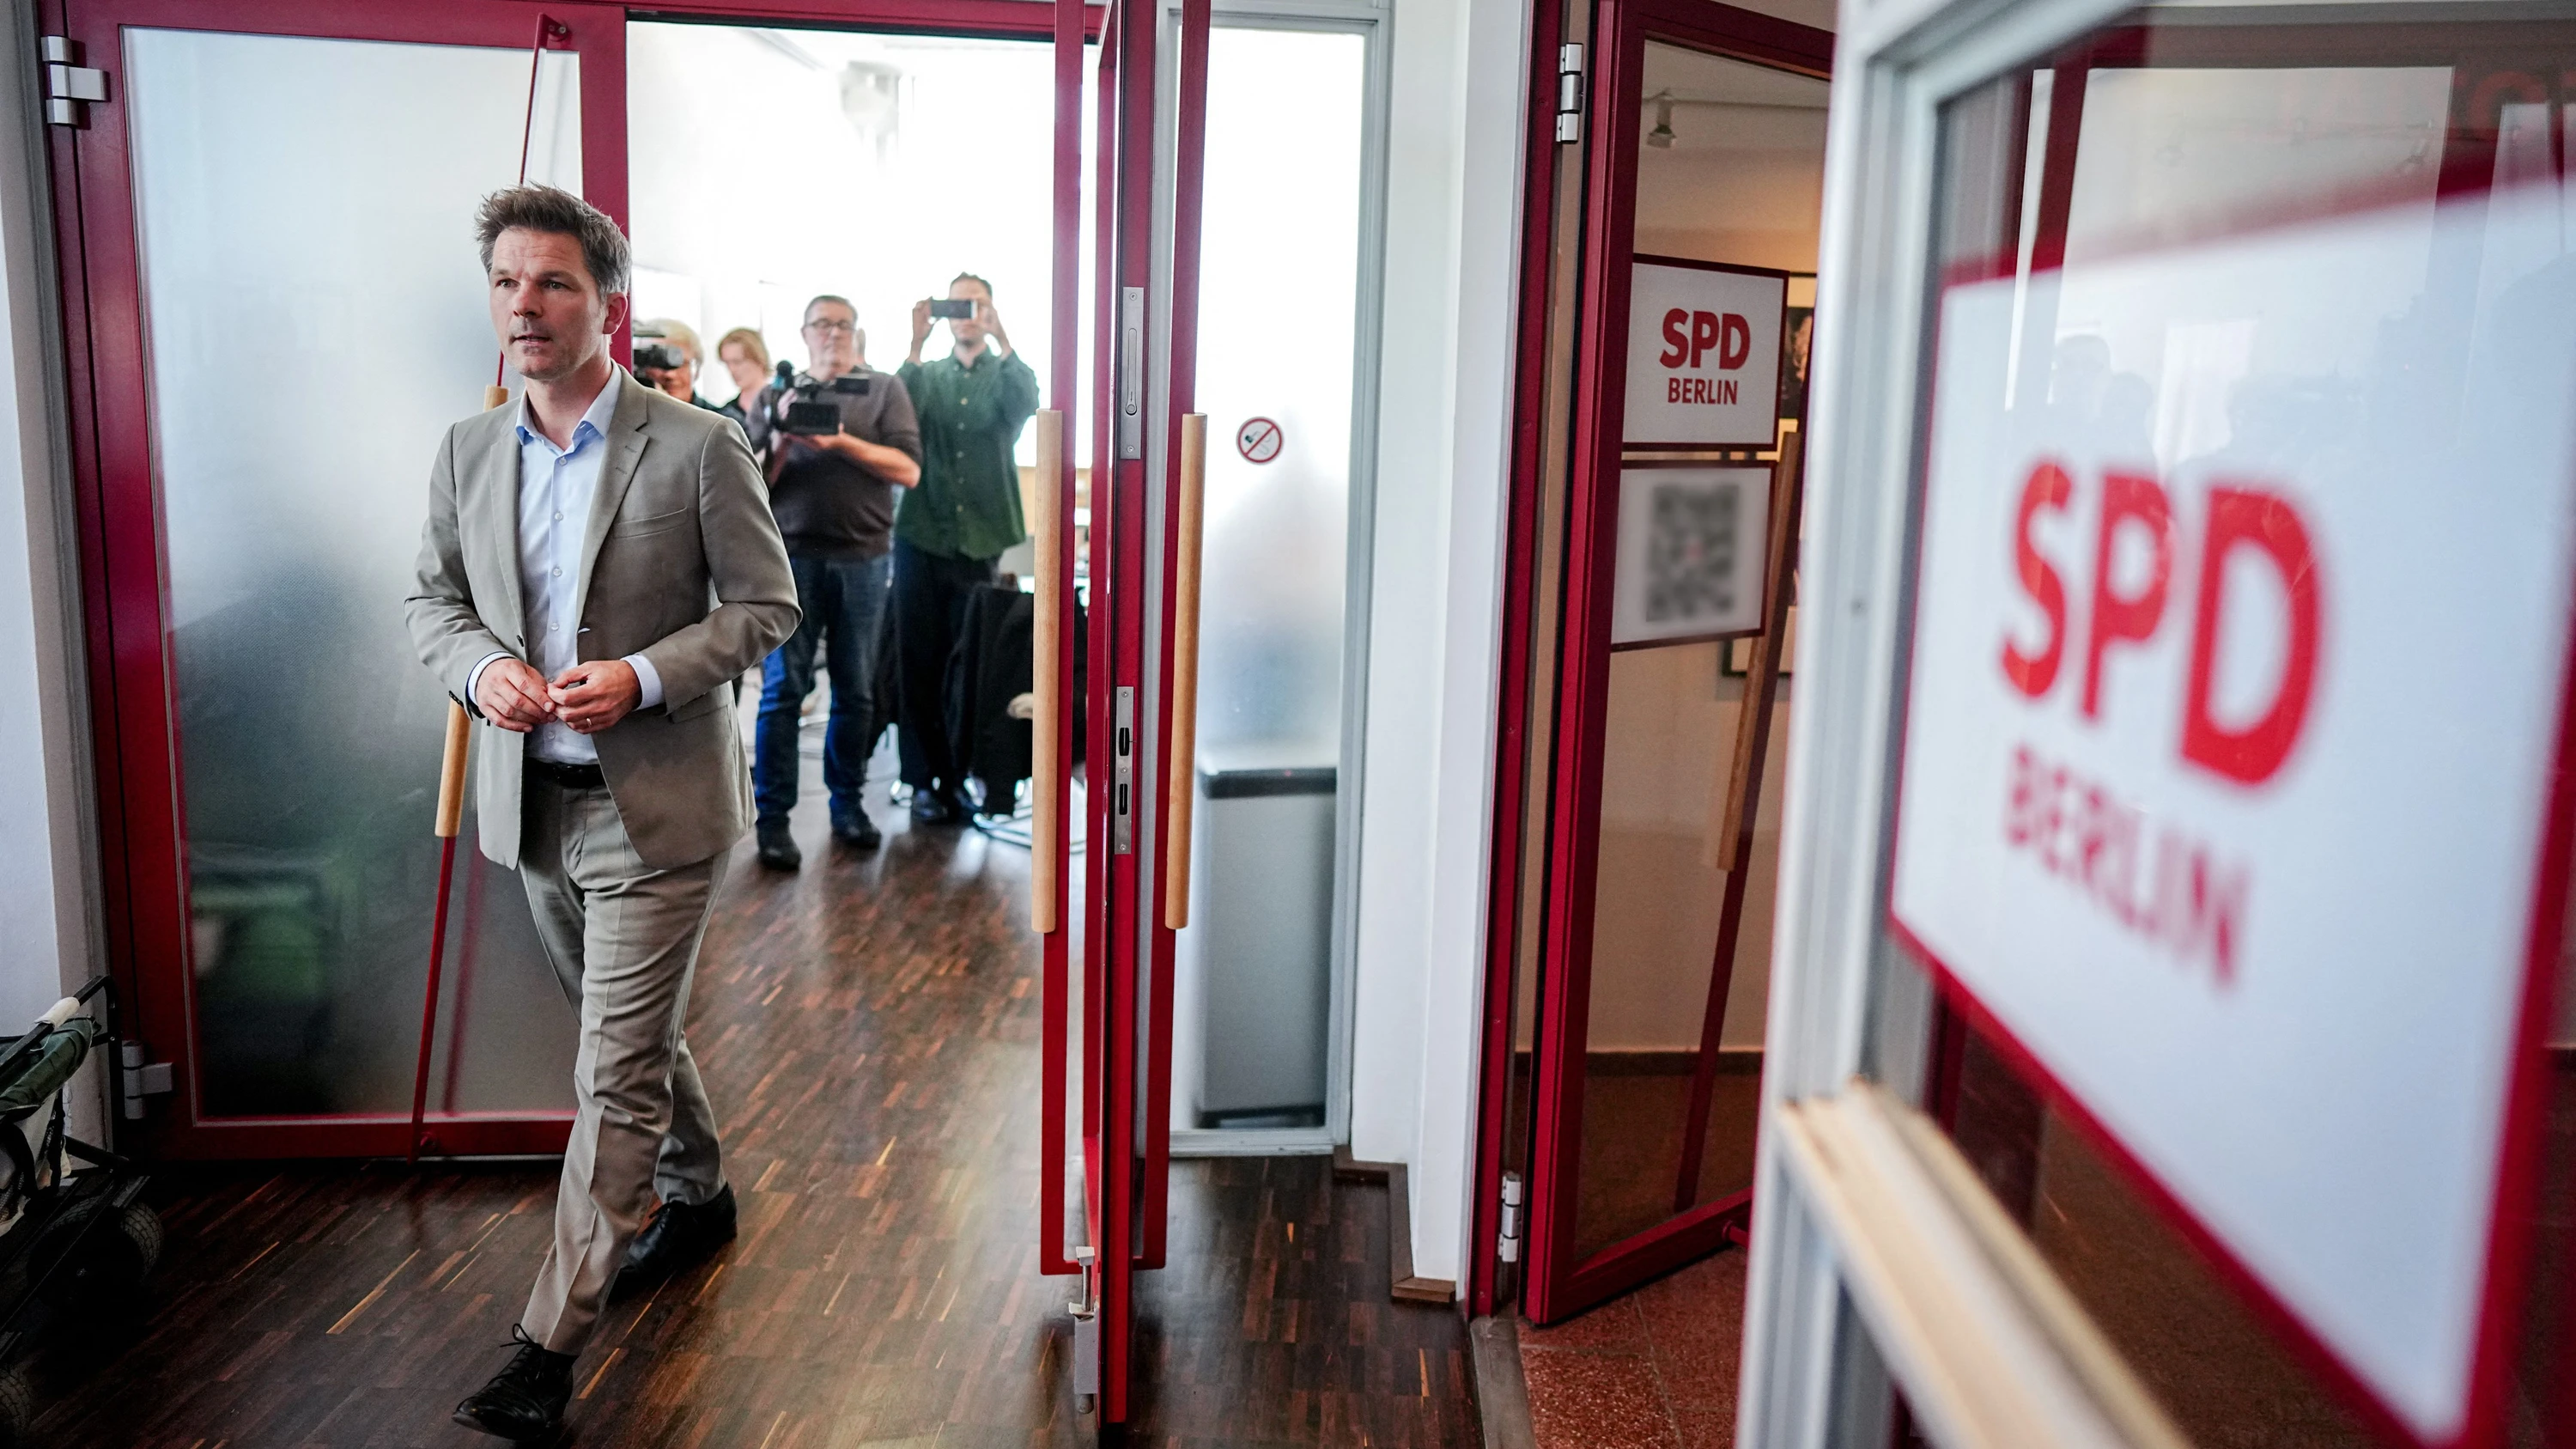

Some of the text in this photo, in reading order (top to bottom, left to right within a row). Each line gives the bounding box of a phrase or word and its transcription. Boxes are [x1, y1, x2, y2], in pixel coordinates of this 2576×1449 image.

[1659, 307, 1751, 370] SPD
[1668, 377, 1738, 405] BERLIN
[1999, 456, 2324, 790] SPD
[2004, 741, 2250, 993] BERLIN
